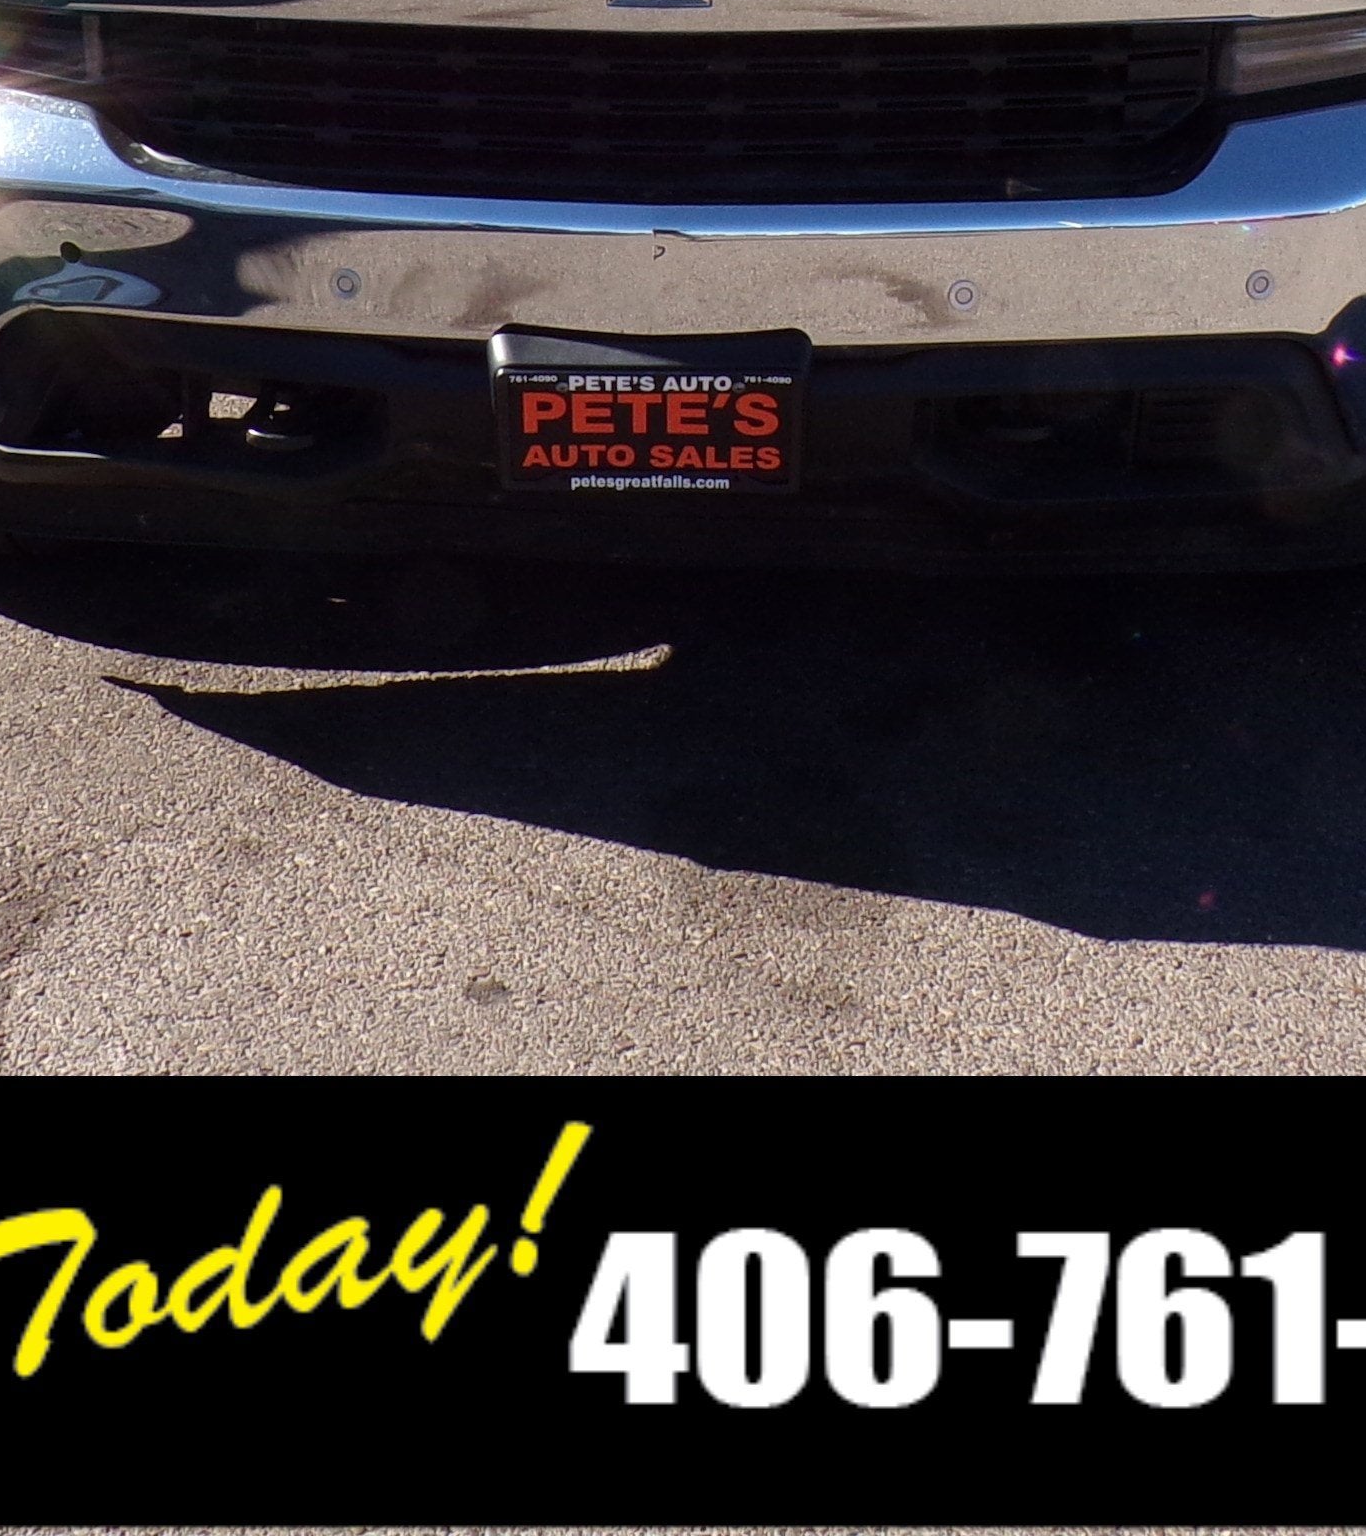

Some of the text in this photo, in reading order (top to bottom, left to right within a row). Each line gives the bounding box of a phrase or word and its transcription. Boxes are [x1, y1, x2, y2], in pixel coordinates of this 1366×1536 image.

[508, 374, 559, 384] 761-4090
[568, 375, 733, 392] PETE'S AUTO
[743, 375, 793, 385] 761-4090
[521, 391, 780, 436] PETE'S
[521, 444, 781, 470] AUTO SALES
[570, 475, 730, 491] petesgreatfalls.com
